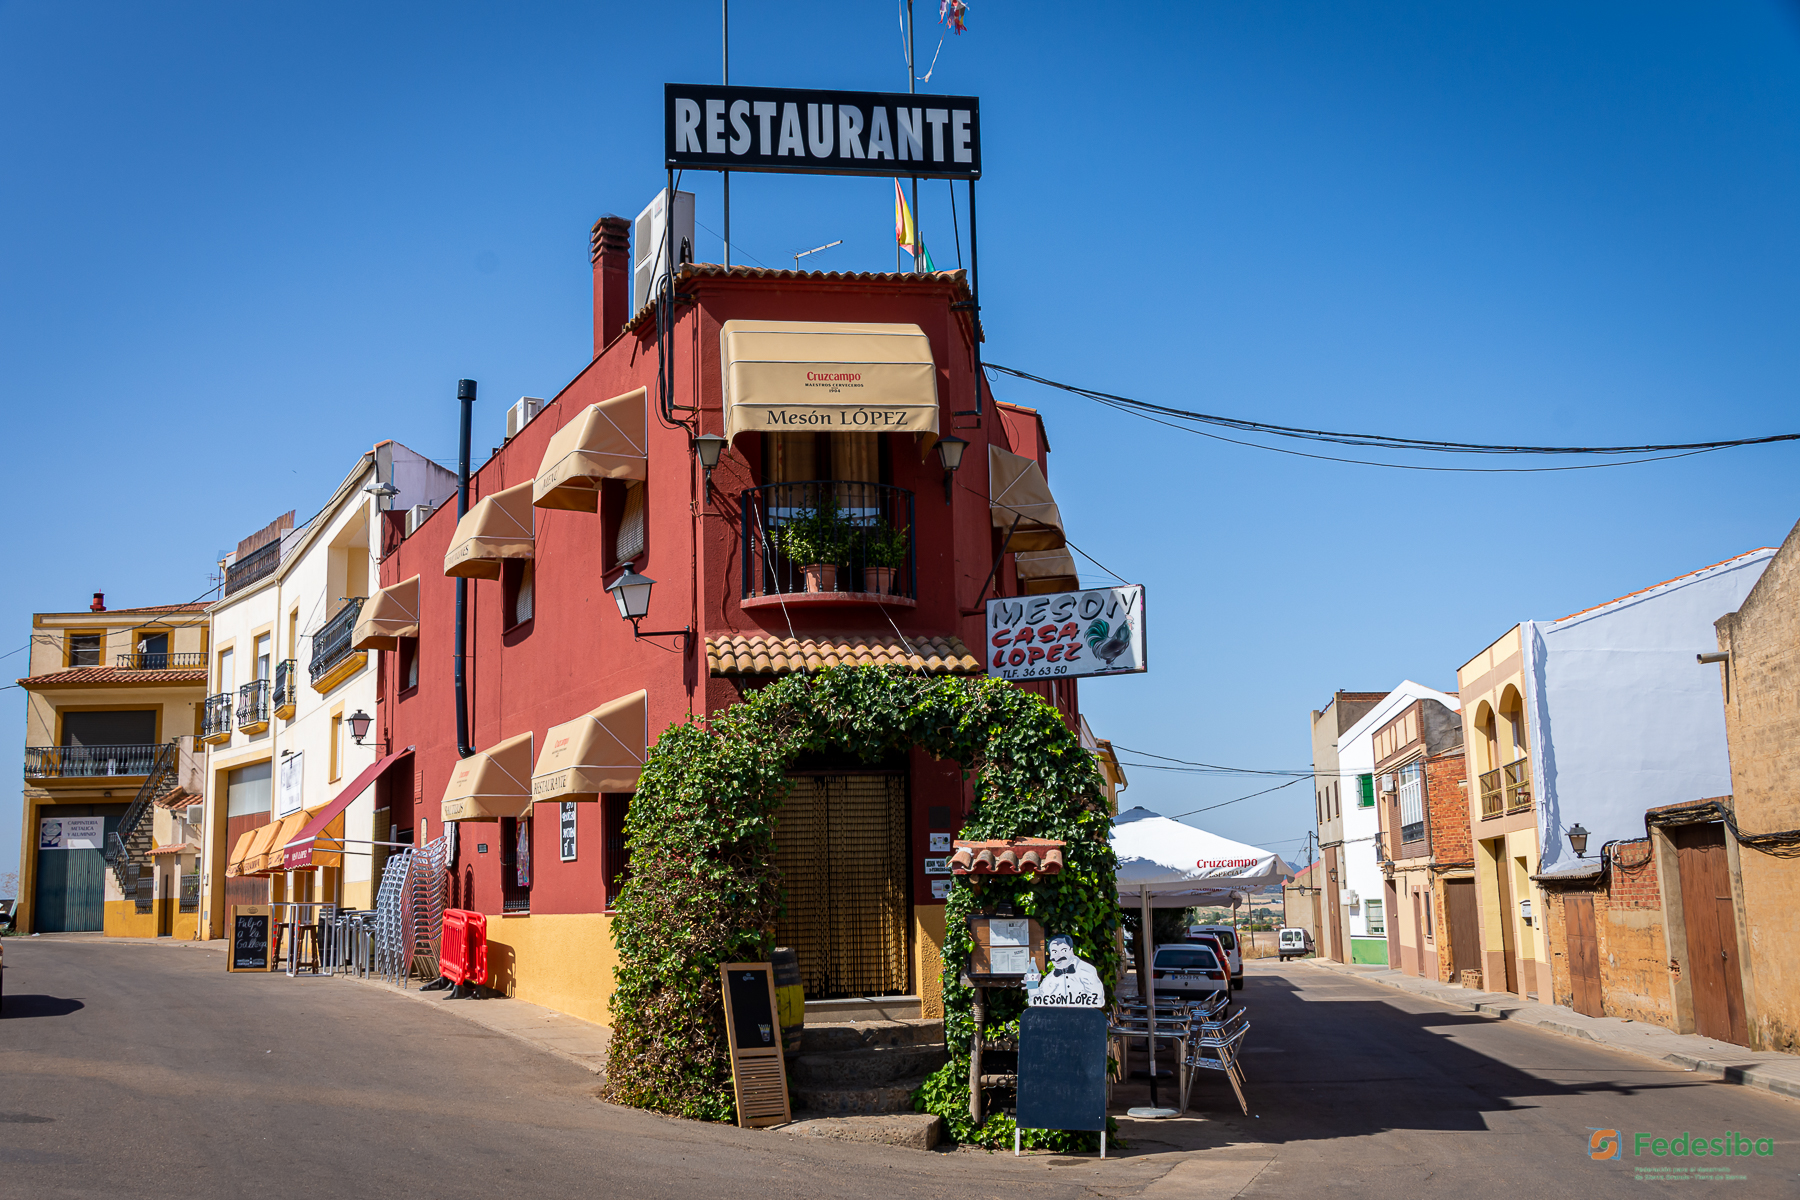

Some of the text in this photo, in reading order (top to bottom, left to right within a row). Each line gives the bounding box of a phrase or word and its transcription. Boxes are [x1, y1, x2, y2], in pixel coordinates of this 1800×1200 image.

[675, 98, 973, 164] RESTAURANTE
[806, 371, 861, 382] Cruzcampo
[766, 407, 908, 426] Mesón LÓPEZ
[992, 589, 1138, 628] MESON
[992, 621, 1080, 648] CASA
[992, 642, 1083, 668] LOPEZ
[1002, 665, 1068, 679] TLF. 36 63 50
[533, 774, 567, 795] RESTAURANTE
[1196, 858, 1258, 869] Cruzcampo
[238, 917, 262, 932] Pulpo
[249, 928, 261, 937] la
[236, 938, 267, 952] Gallega
[1033, 991, 1099, 1005] MESÓN LÓPEZ
